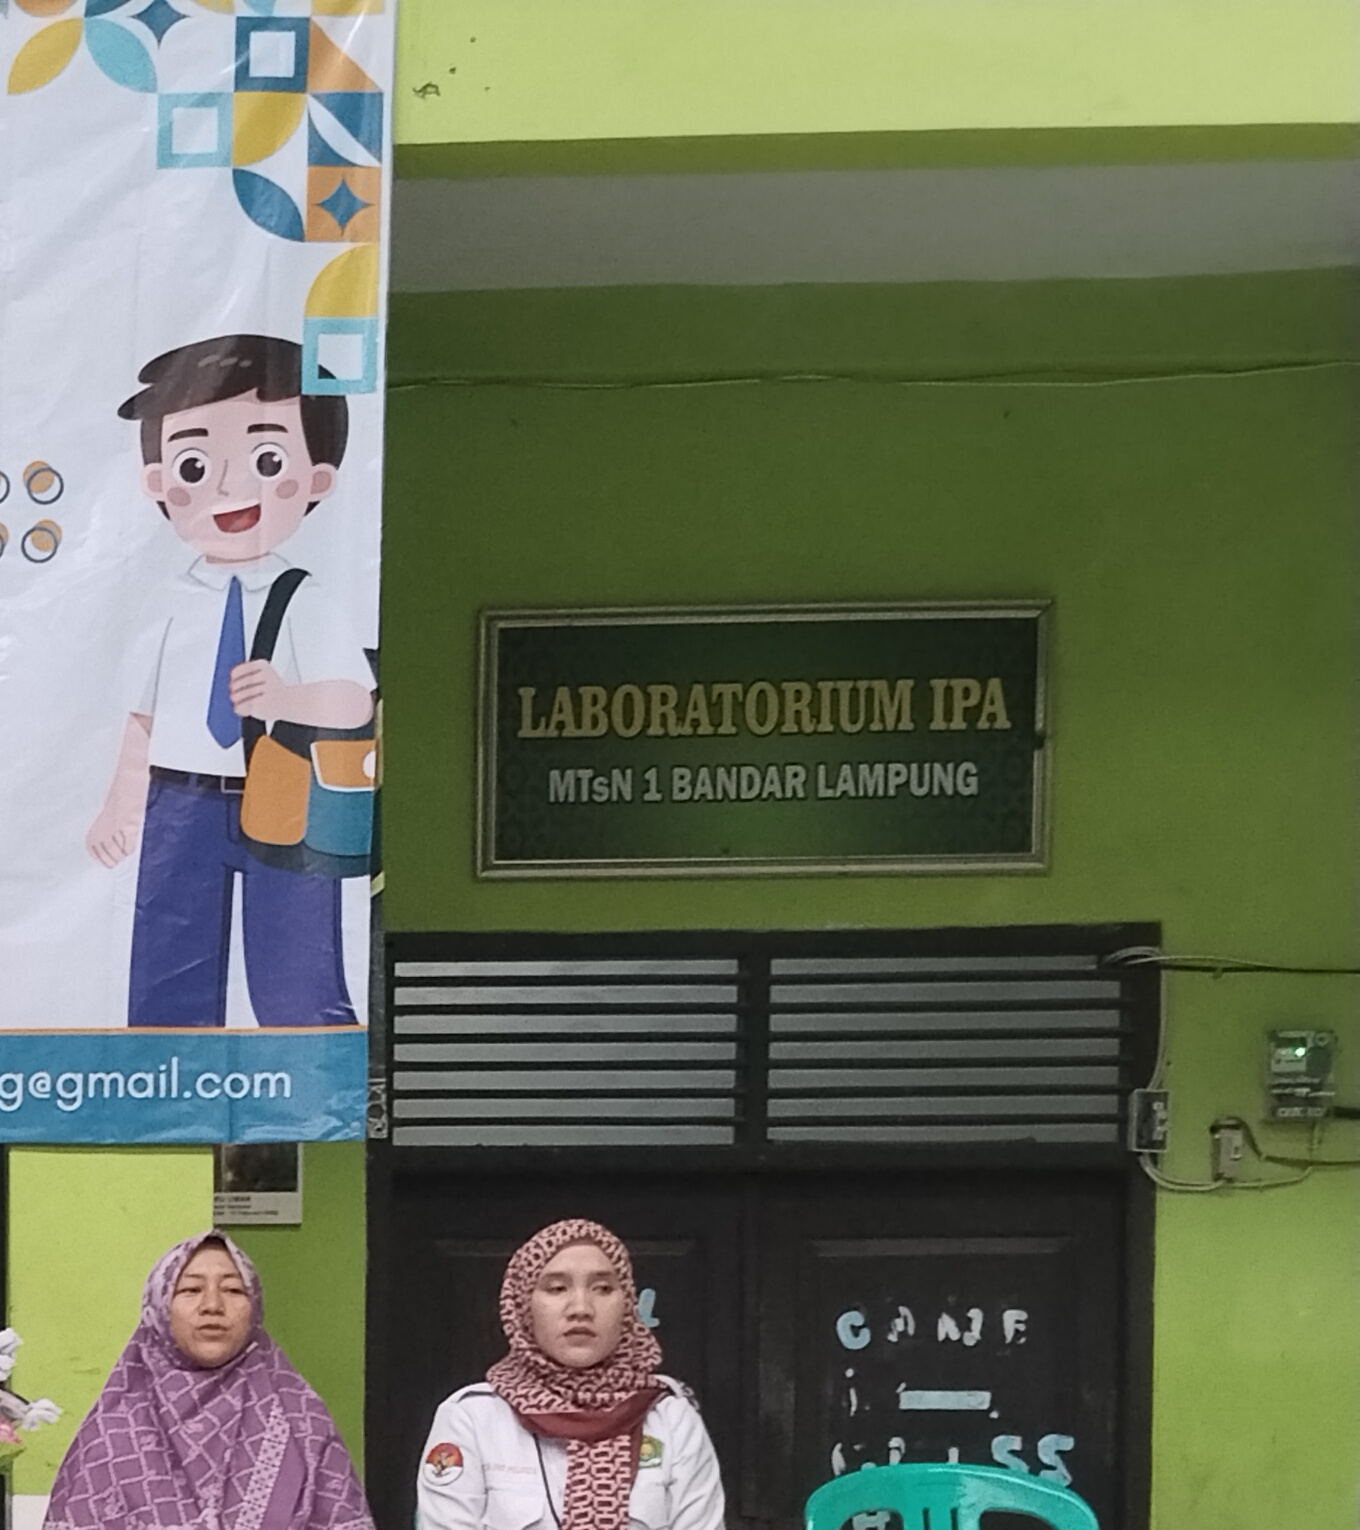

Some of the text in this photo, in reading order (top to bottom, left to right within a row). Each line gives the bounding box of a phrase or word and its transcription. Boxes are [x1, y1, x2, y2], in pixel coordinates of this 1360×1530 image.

[517, 677, 1011, 738] LABORATORIUM IPA
[548, 761, 979, 803] MTsN 1 BANDAR LAMPUNG
